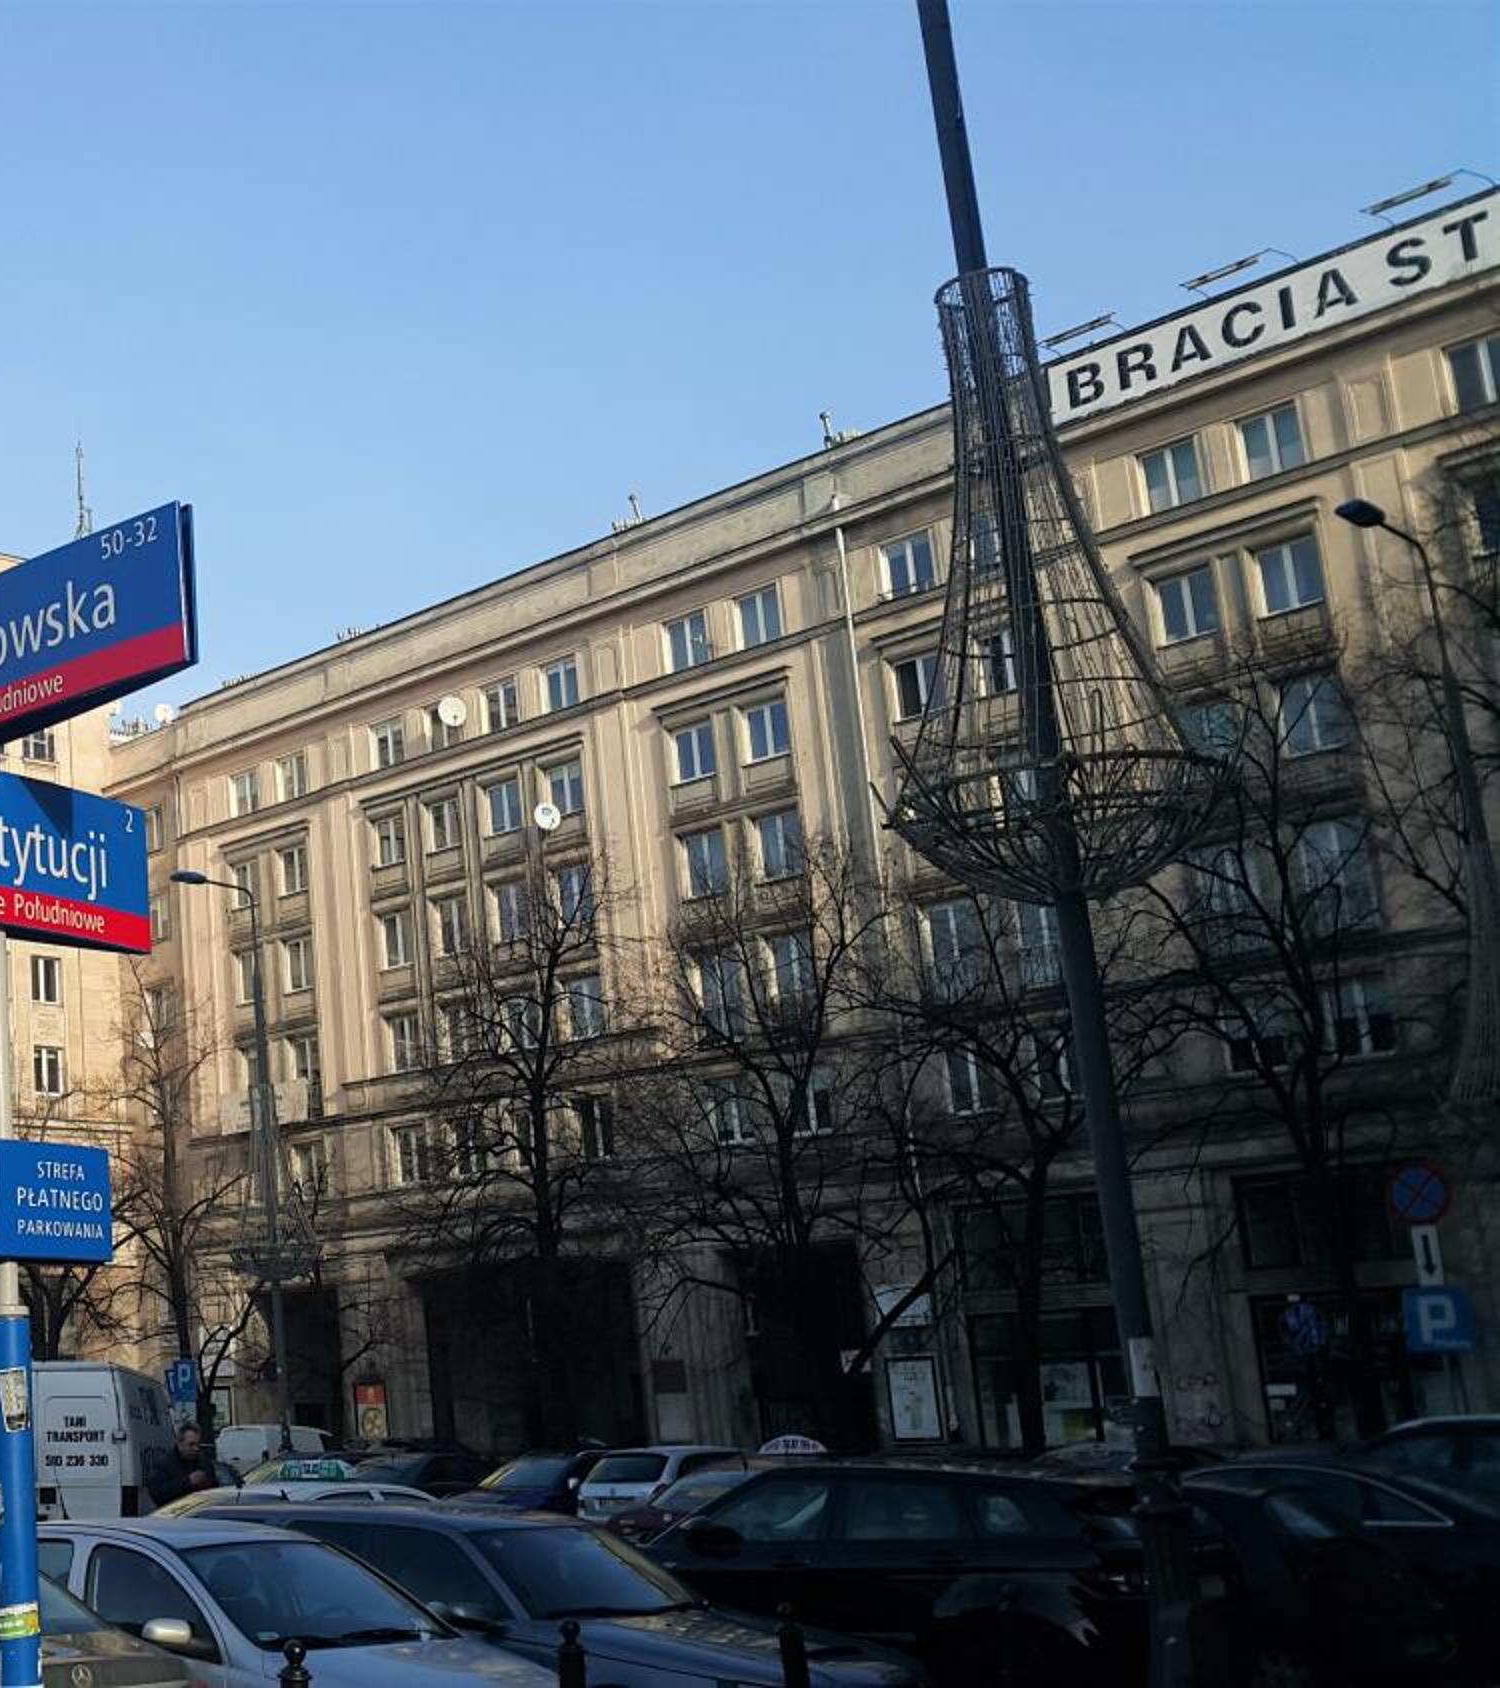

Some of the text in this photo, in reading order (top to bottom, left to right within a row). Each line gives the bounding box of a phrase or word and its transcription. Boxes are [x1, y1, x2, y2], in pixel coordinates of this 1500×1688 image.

[1065, 211, 1489, 409] BRACIA ST
[100, 516, 158, 560] 50-32
[125, 809, 134, 833] 2
[14, 890, 106, 933] Południowe
[37, 1161, 85, 1181] STREFA
[17, 1186, 103, 1212] PŁATNEGO
[17, 1219, 104, 1240] PARKOWANIA
[1418, 1295, 1456, 1344] P
[47, 1430, 104, 1442] TRANSPORT
